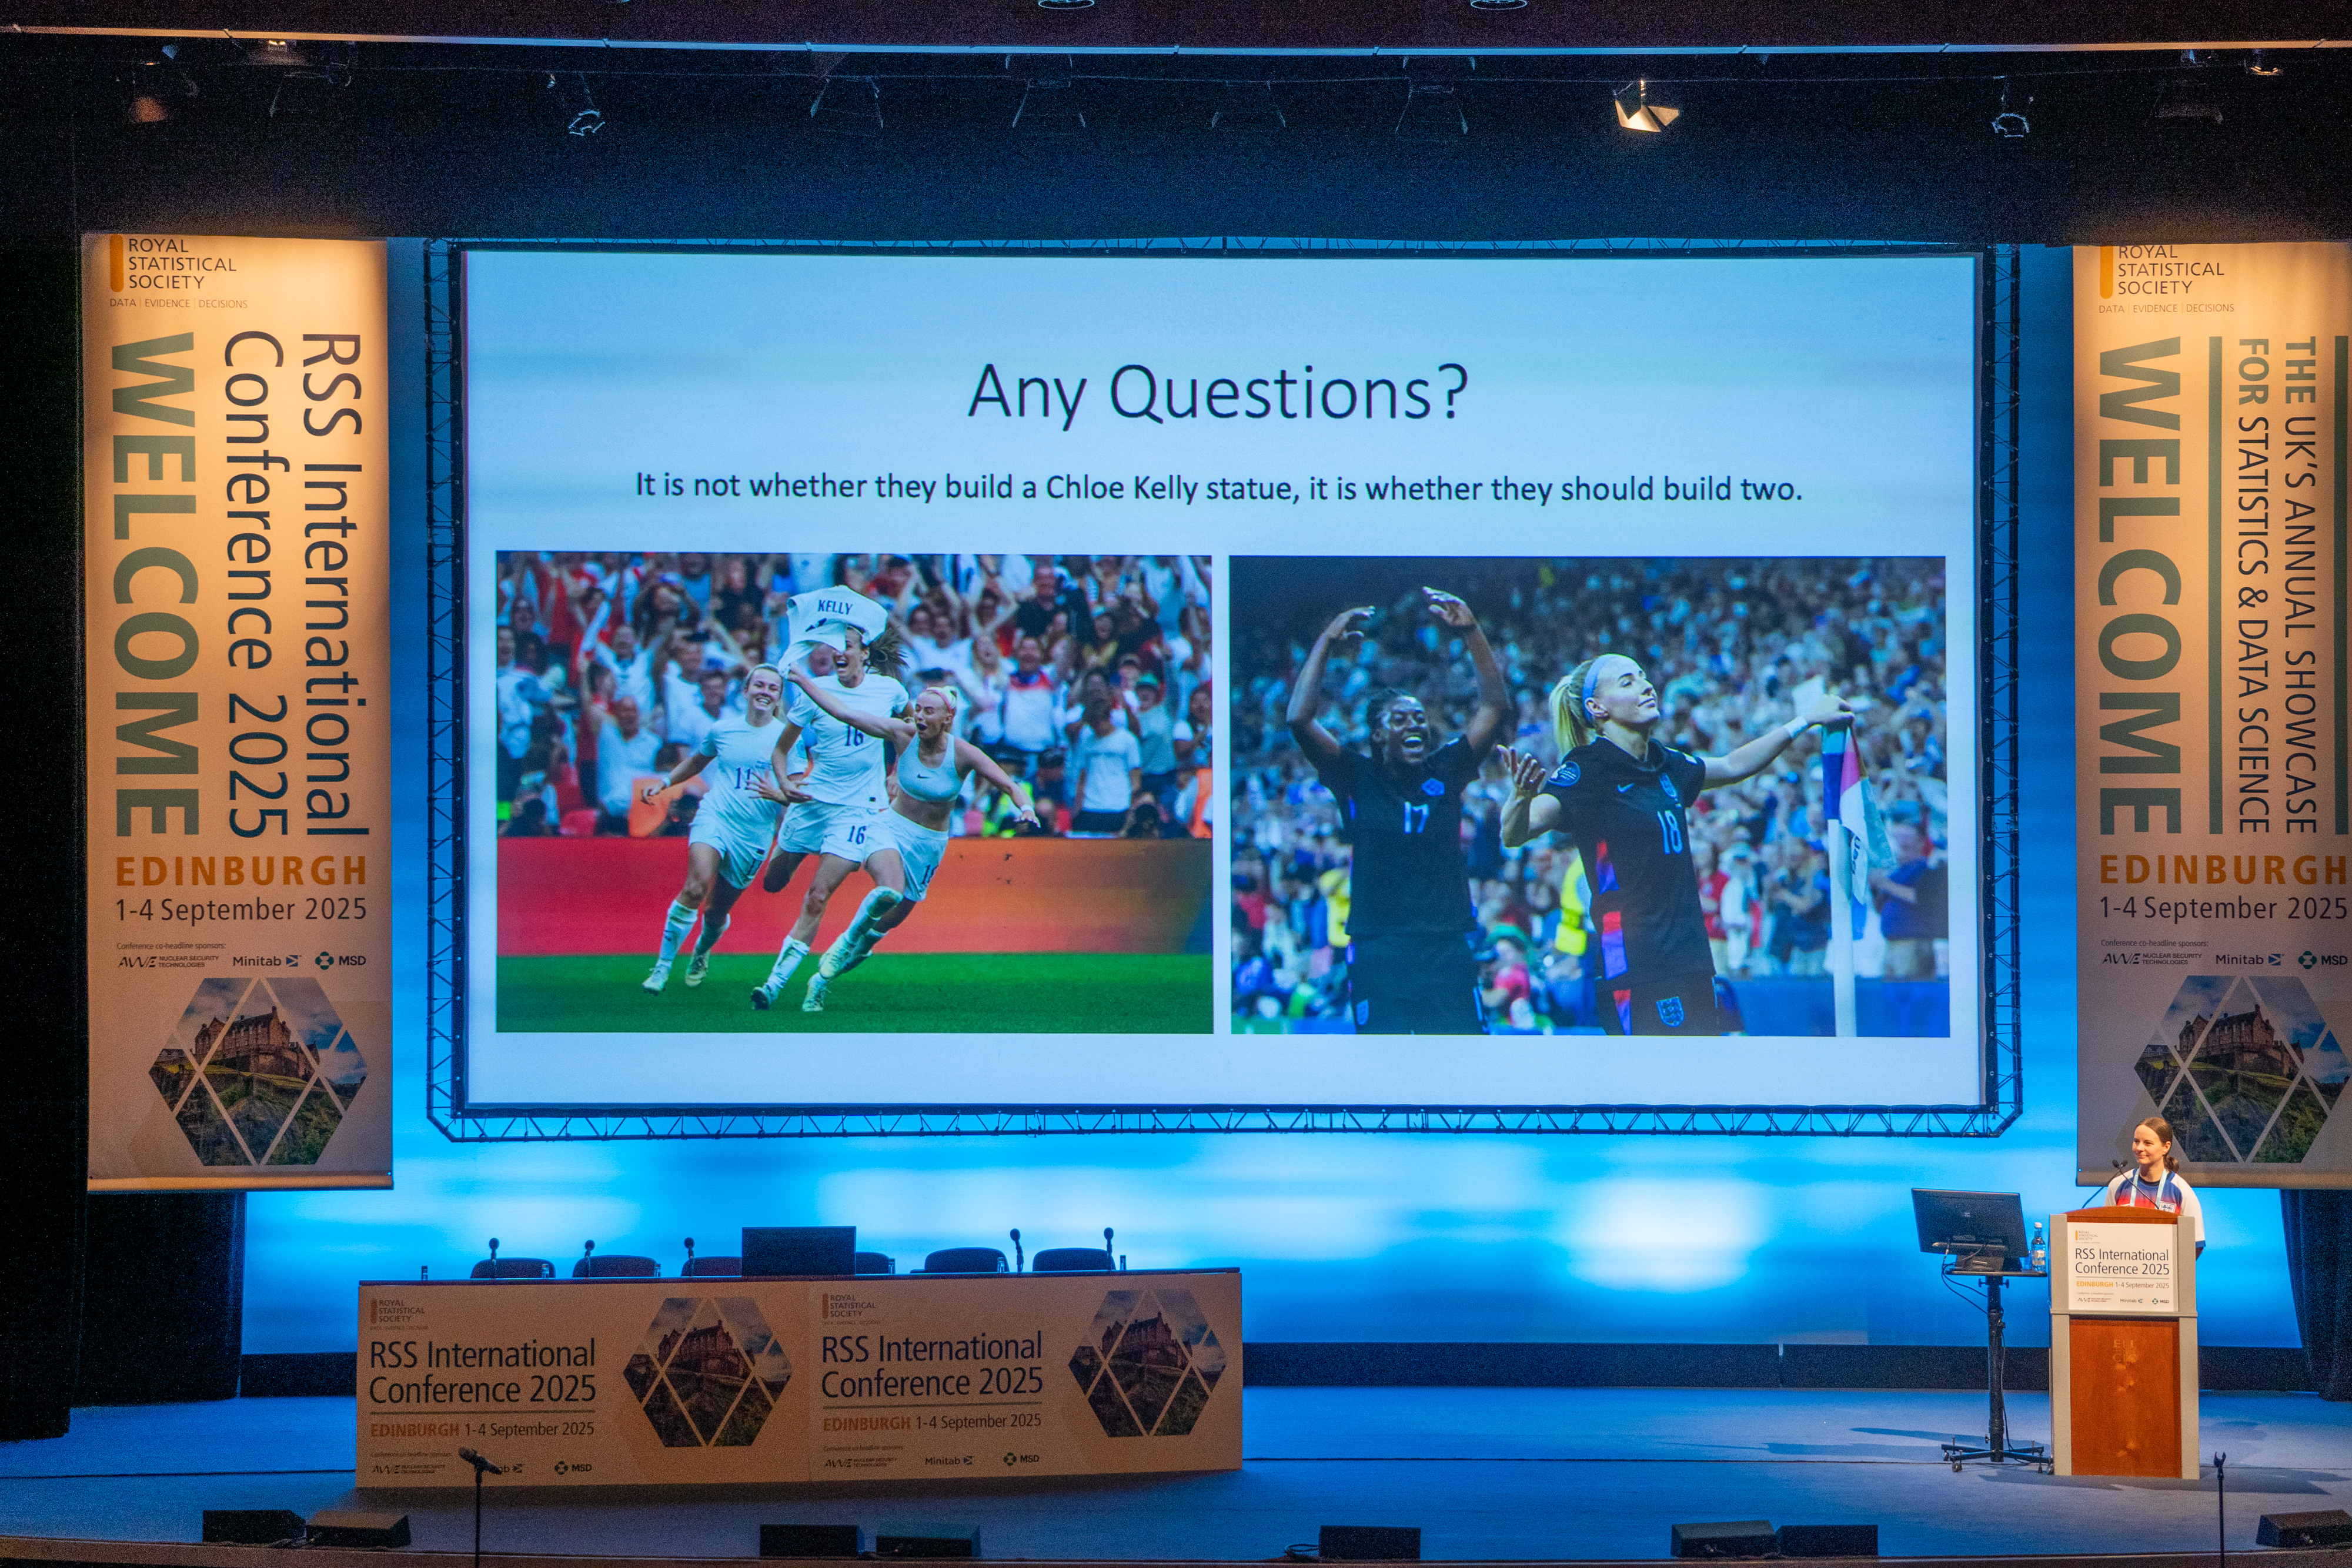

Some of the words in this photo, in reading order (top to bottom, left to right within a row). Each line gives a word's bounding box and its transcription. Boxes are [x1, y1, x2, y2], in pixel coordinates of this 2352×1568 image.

[129, 238, 189, 253] ROYAL
[2119, 245, 2178, 259] ROYAL
[129, 257, 237, 272] STATISTICAL
[2118, 262, 2224, 277] STATISTICAL
[129, 275, 205, 289] SOCIETY
[2118, 281, 2193, 295] SOCIETY
[110, 298, 136, 307] DATA
[145, 299, 191, 308] EVIDENCE
[199, 299, 248, 309] DECISIONS
[2099, 305, 2124, 313] DATA
[2133, 304, 2178, 313] EVIDENCE
[2186, 303, 2234, 312] DECISIONS
[2239, 339, 2270, 406] FOR
[2285, 336, 2316, 404] THE
[302, 333, 363, 437] RSS
[968, 363, 1087, 432] Any
[1110, 363, 1469, 424] Questions?
[225, 330, 290, 670] Conference
[637, 472, 656, 496] It
[664, 472, 684, 496] is
[694, 475, 741, 497] not
[750, 472, 868, 497] whether
[875, 473, 937, 504] they
[946, 473, 1013, 499] build
[1023, 481, 1037, 499] a
[1047, 474, 1125, 499] Chloe
[1134, 474, 1199, 506] Kelly
[1207, 478, 1299, 504] statue,
[1310, 476, 1328, 500] it
[1337, 476, 1357, 500] is
[1365, 475, 1483, 500] whether
[1491, 476, 1553, 506] they
[1561, 476, 1653, 501] should
[1665, 476, 1731, 501] build
[1740, 478, 1802, 501] two.
[2238, 417, 2269, 576] STATISTICS
[2284, 499, 2316, 638] ANNUAL
[112, 332, 199, 837] WELCOME
[2098, 336, 2182, 835] WELCOME
[2238, 587, 2269, 609] &
[818, 599, 853, 615] KELLY
[304, 464, 370, 836] International
[2238, 620, 2269, 698] DATA
[846, 726, 864, 747] 16
[2285, 650, 2317, 834] SHOWCASE
[229, 693, 288, 838] 2025
[2239, 708, 2270, 833] SCIENCE
[1404, 801, 1429, 834] 17
[847, 825, 867, 845] 16
[1657, 810, 1683, 855] 18
[116, 856, 366, 886] EDINBURGH
[2100, 855, 2346, 885] EDINBURGH
[116, 899, 154, 921] 1-4
[161, 897, 295, 927] September
[305, 897, 367, 920] 2025
[2100, 896, 2137, 918] 1-4
[2144, 895, 2277, 924] September
[2287, 897, 2347, 919] 2025
[233, 955, 282, 967] Minitab
[339, 955, 366, 966] MSD
[2216, 954, 2264, 965] Minitab
[2321, 955, 2348, 965] MSD
[2075, 1248, 2095, 1259] RSS
[2099, 1249, 2169, 1261] International
[2075, 1262, 2139, 1275] Conference
[2141, 1263, 2170, 1275] 2025
[370, 1340, 418, 1369] RSS
[428, 1338, 595, 1368] International
[823, 1335, 869, 1363] RSS
[880, 1330, 1041, 1362] International
[369, 1373, 521, 1404] Conference
[530, 1375, 596, 1402] 2025
[822, 1368, 970, 1398] Conference
[979, 1367, 1043, 1395] 2025
[370, 1423, 459, 1437] EDINBURGH
[465, 1423, 486, 1436] 1-4
[490, 1422, 559, 1439] September
[562, 1422, 595, 1436] 2025
[823, 1416, 911, 1432] EDINBURGH
[916, 1416, 937, 1429] 1-4
[941, 1414, 1007, 1432] September
[1011, 1413, 1042, 1427] 2025
[572, 1463, 593, 1472] MSD
[925, 1456, 961, 1466] Minitab
[1020, 1455, 1040, 1463] MSD
